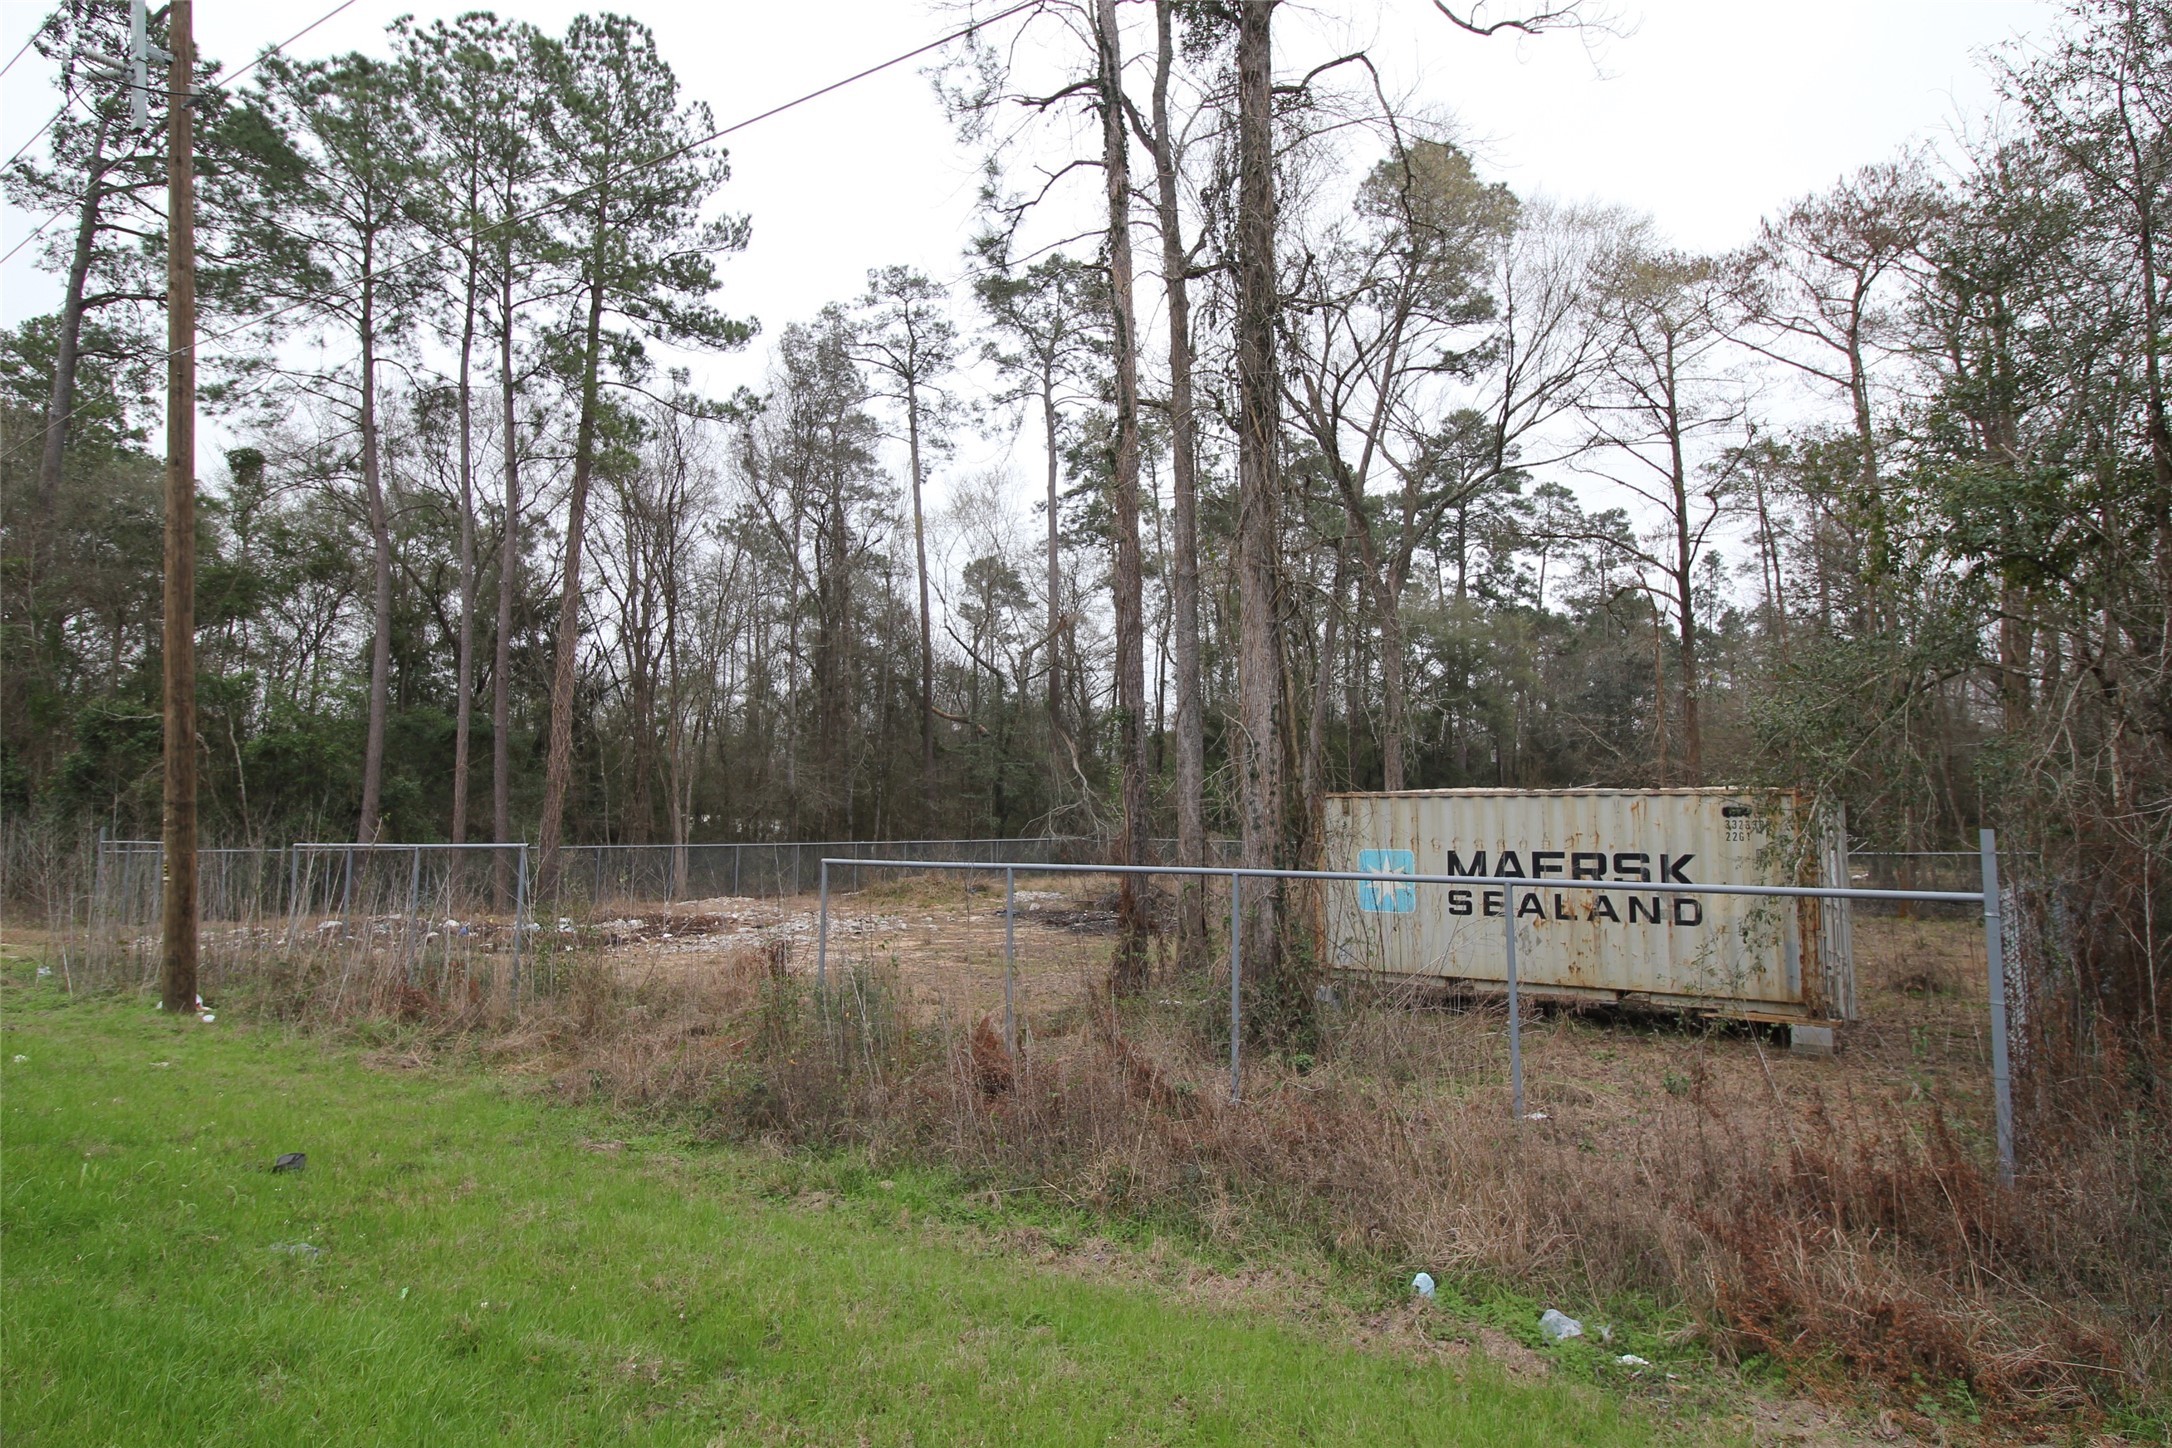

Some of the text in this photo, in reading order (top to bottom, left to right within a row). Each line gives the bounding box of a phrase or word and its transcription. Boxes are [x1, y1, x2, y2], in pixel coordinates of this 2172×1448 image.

[1725, 832, 1751, 842] 22G1
[1447, 850, 1696, 884] MAERSK
[1448, 889, 1703, 926] SEALAND
